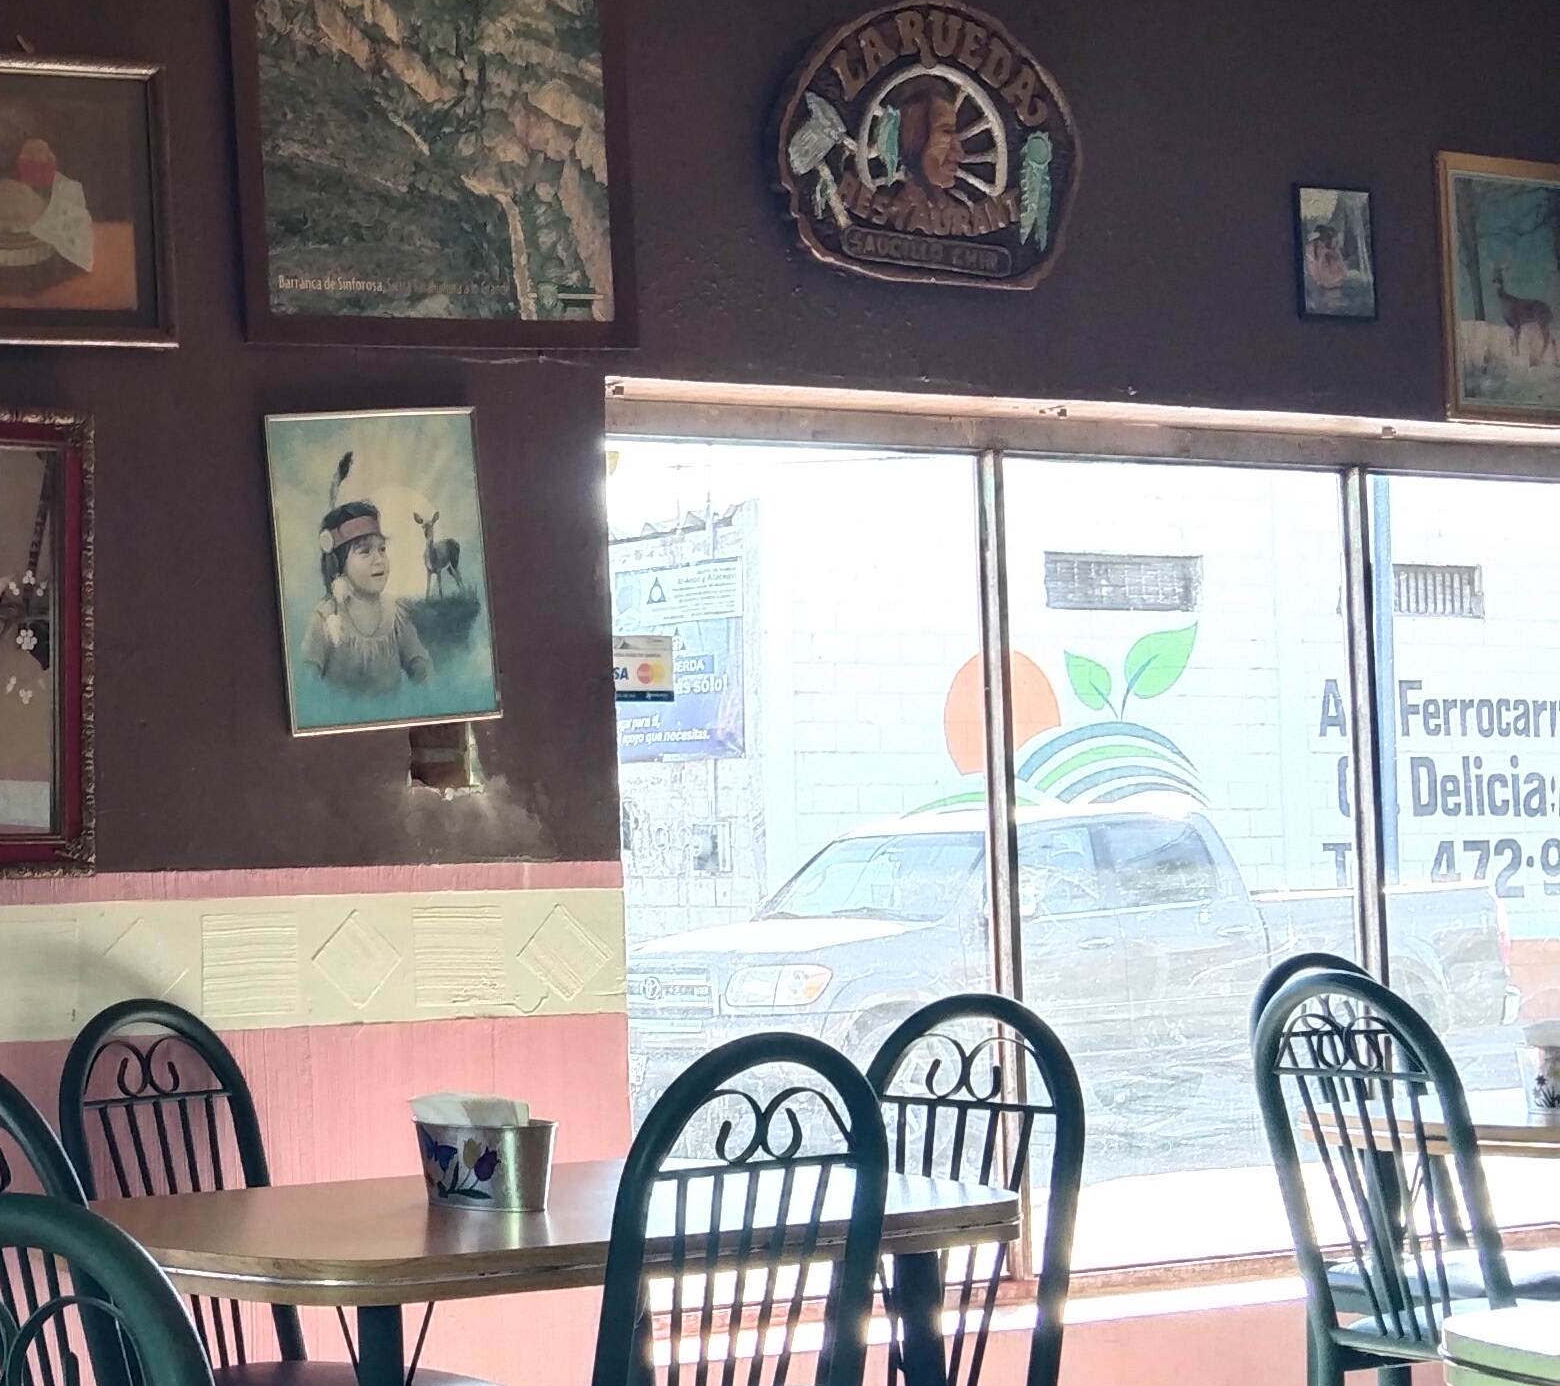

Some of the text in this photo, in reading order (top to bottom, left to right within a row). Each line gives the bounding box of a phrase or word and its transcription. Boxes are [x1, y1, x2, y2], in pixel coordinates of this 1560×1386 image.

[831, 10, 1049, 127] LA RUEDA
[836, 170, 1020, 238] RESTAURANT
[278, 274, 322, 291] Barranca
[324, 275, 337, 291] de
